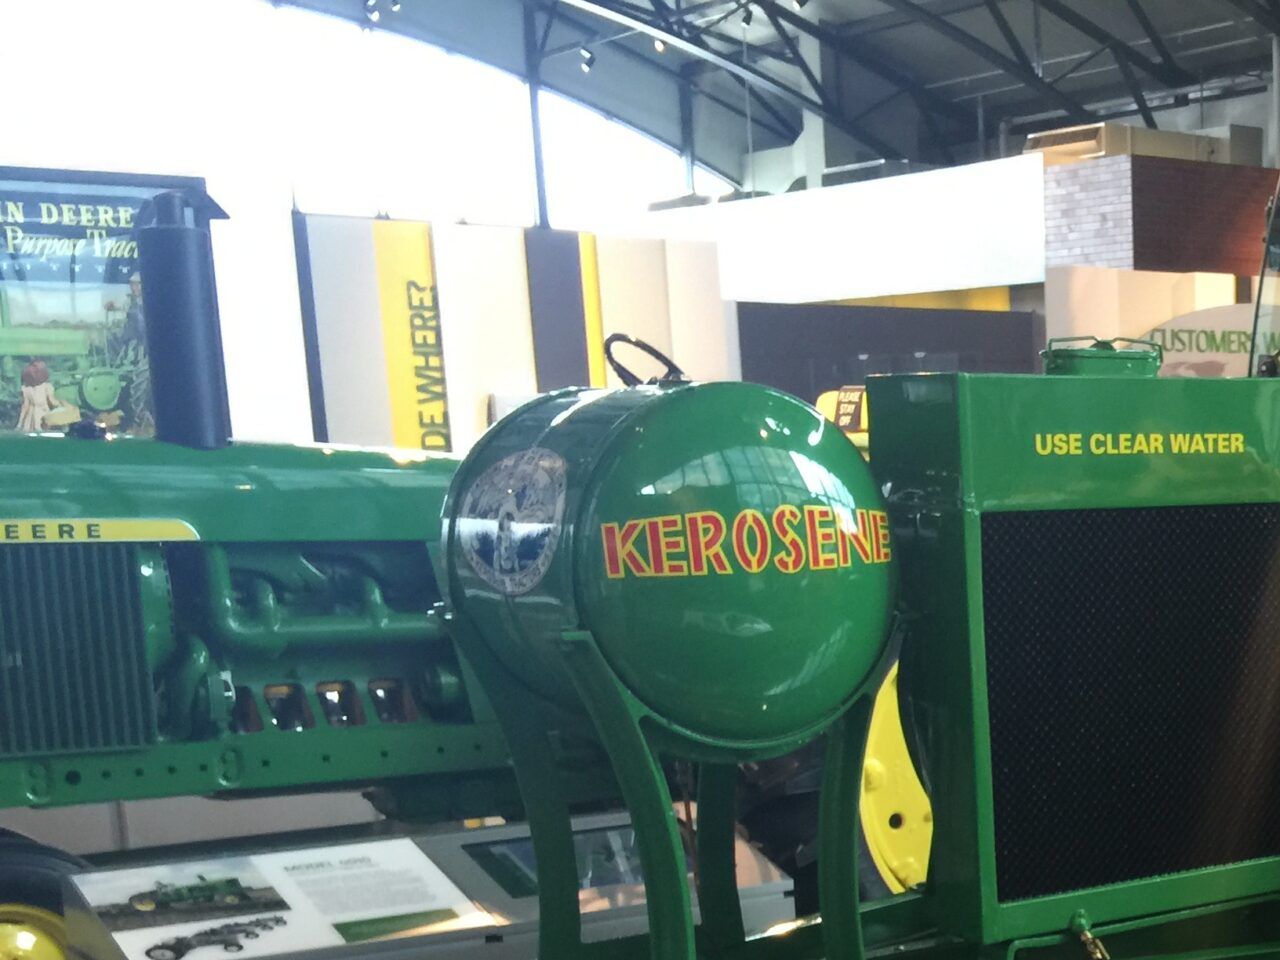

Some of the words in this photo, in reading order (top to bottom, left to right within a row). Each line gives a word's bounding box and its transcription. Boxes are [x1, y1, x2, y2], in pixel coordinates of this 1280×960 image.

[0, 201, 24, 223] N
[38, 202, 134, 228] DEERE
[5, 225, 86, 262] Purpose
[406, 279, 446, 405] WHERE?
[1034, 433, 1082, 455] USE
[1089, 433, 1164, 455] CLEAR
[1169, 433, 1245, 454] WATER
[4, 523, 101, 540] EERE
[601, 504, 891, 579] KEROSENE
